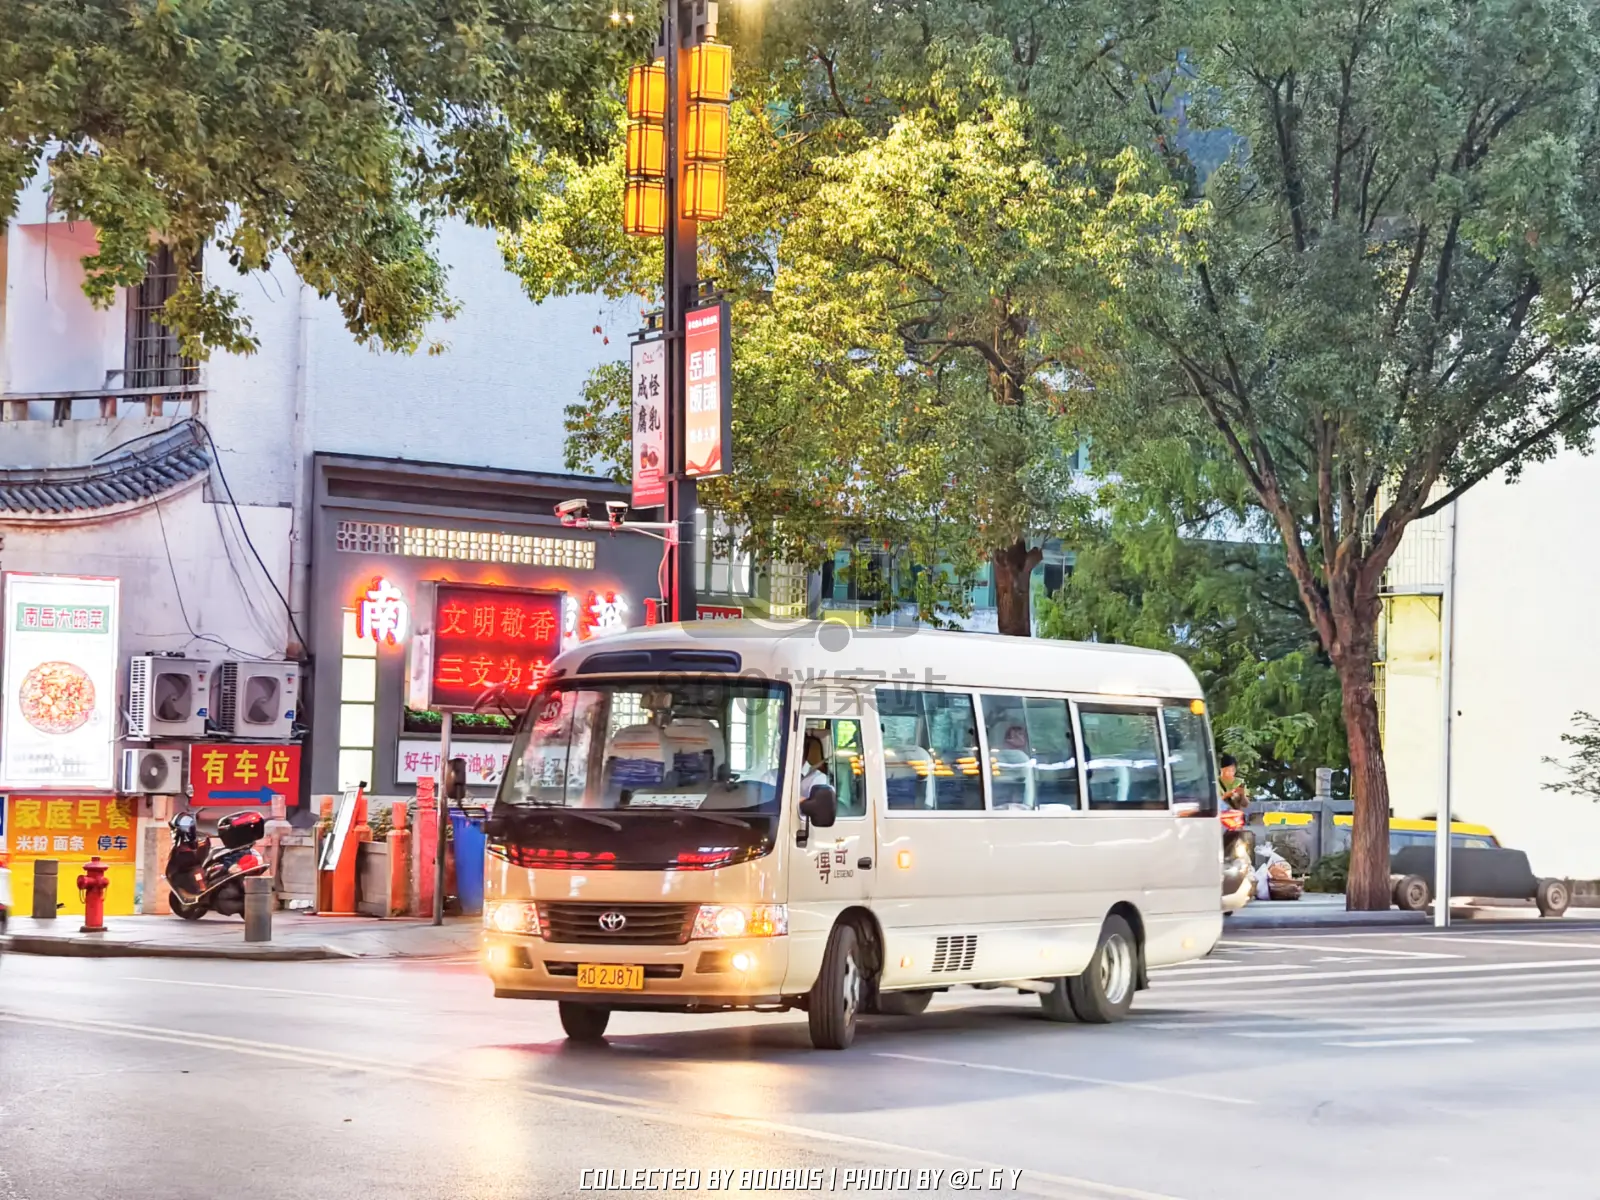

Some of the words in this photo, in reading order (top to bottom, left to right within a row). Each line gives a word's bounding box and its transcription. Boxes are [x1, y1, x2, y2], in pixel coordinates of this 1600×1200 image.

[23, 606, 104, 629] 南岳大碗菜
[439, 602, 556, 641] 文明敬香
[201, 750, 291, 785] 有车位
[14, 799, 132, 830] 家庭早餐
[16, 836, 48, 851] 米粉
[53, 836, 84, 851] 面条
[97, 835, 128, 851] 停车
